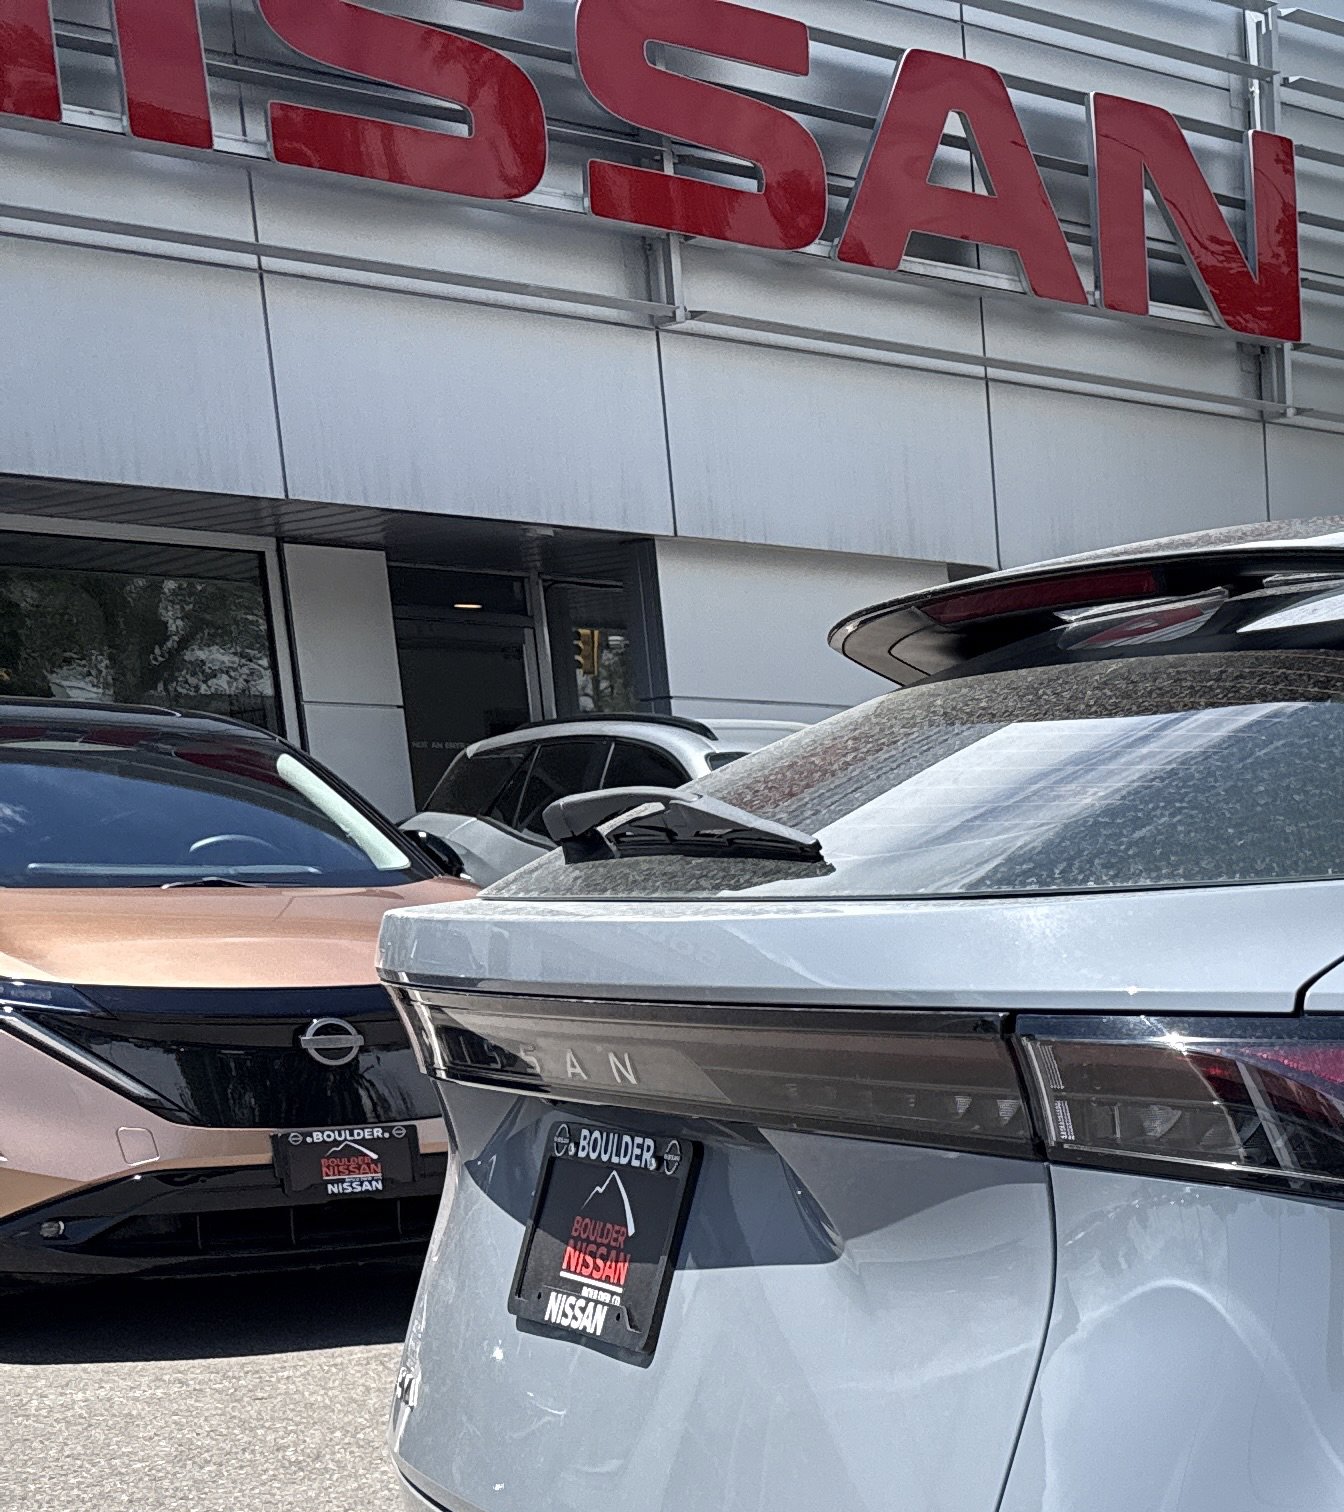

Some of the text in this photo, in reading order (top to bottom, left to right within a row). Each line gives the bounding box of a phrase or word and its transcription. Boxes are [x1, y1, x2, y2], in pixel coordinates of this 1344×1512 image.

[0, 0, 1302, 343] ISSAN
[312, 1128, 383, 1142] BOULDER
[577, 1128, 656, 1168] BOULDER
[321, 1156, 372, 1166] BOULDER
[322, 1163, 382, 1176] NISSAN
[327, 1180, 383, 1194] NISSAN
[571, 1216, 627, 1248] BOULDER
[562, 1239, 630, 1285] NISSAN
[544, 1291, 609, 1336] NISSAN
